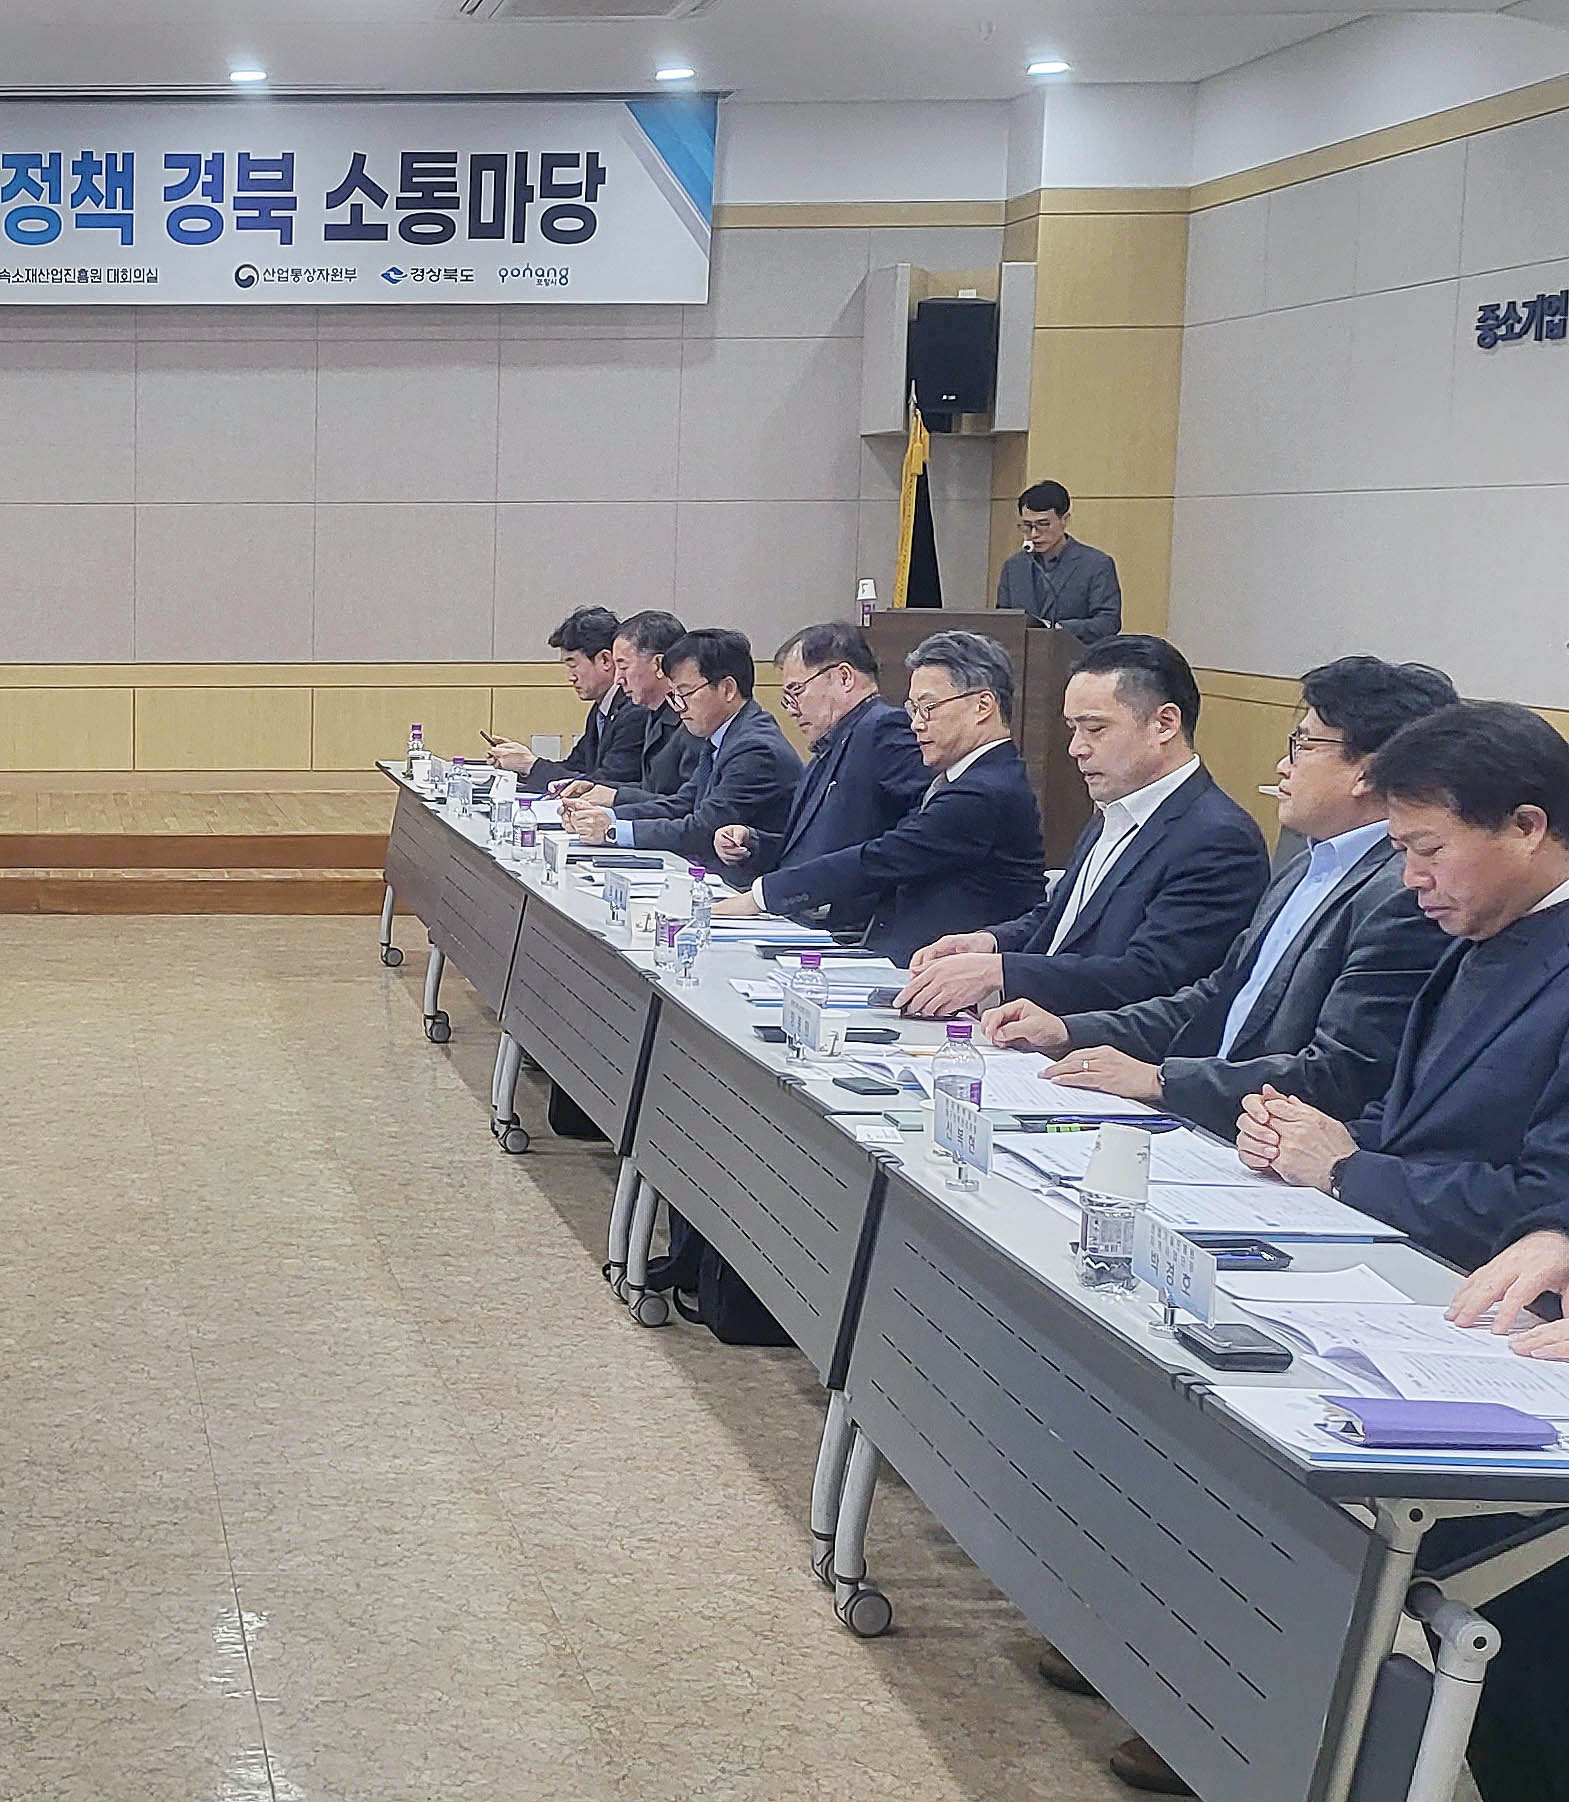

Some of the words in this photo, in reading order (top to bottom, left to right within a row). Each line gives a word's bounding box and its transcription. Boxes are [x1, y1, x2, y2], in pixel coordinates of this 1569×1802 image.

[163, 151, 298, 246] 경북
[324, 151, 607, 246] 소통마당
[106, 267, 159, 285] 대회의실
[262, 267, 359, 284] 산업통상자원부
[410, 267, 475, 284] 경상북도
[498, 262, 569, 286] pohang
[1475, 289, 1569, 349] 중소기업
